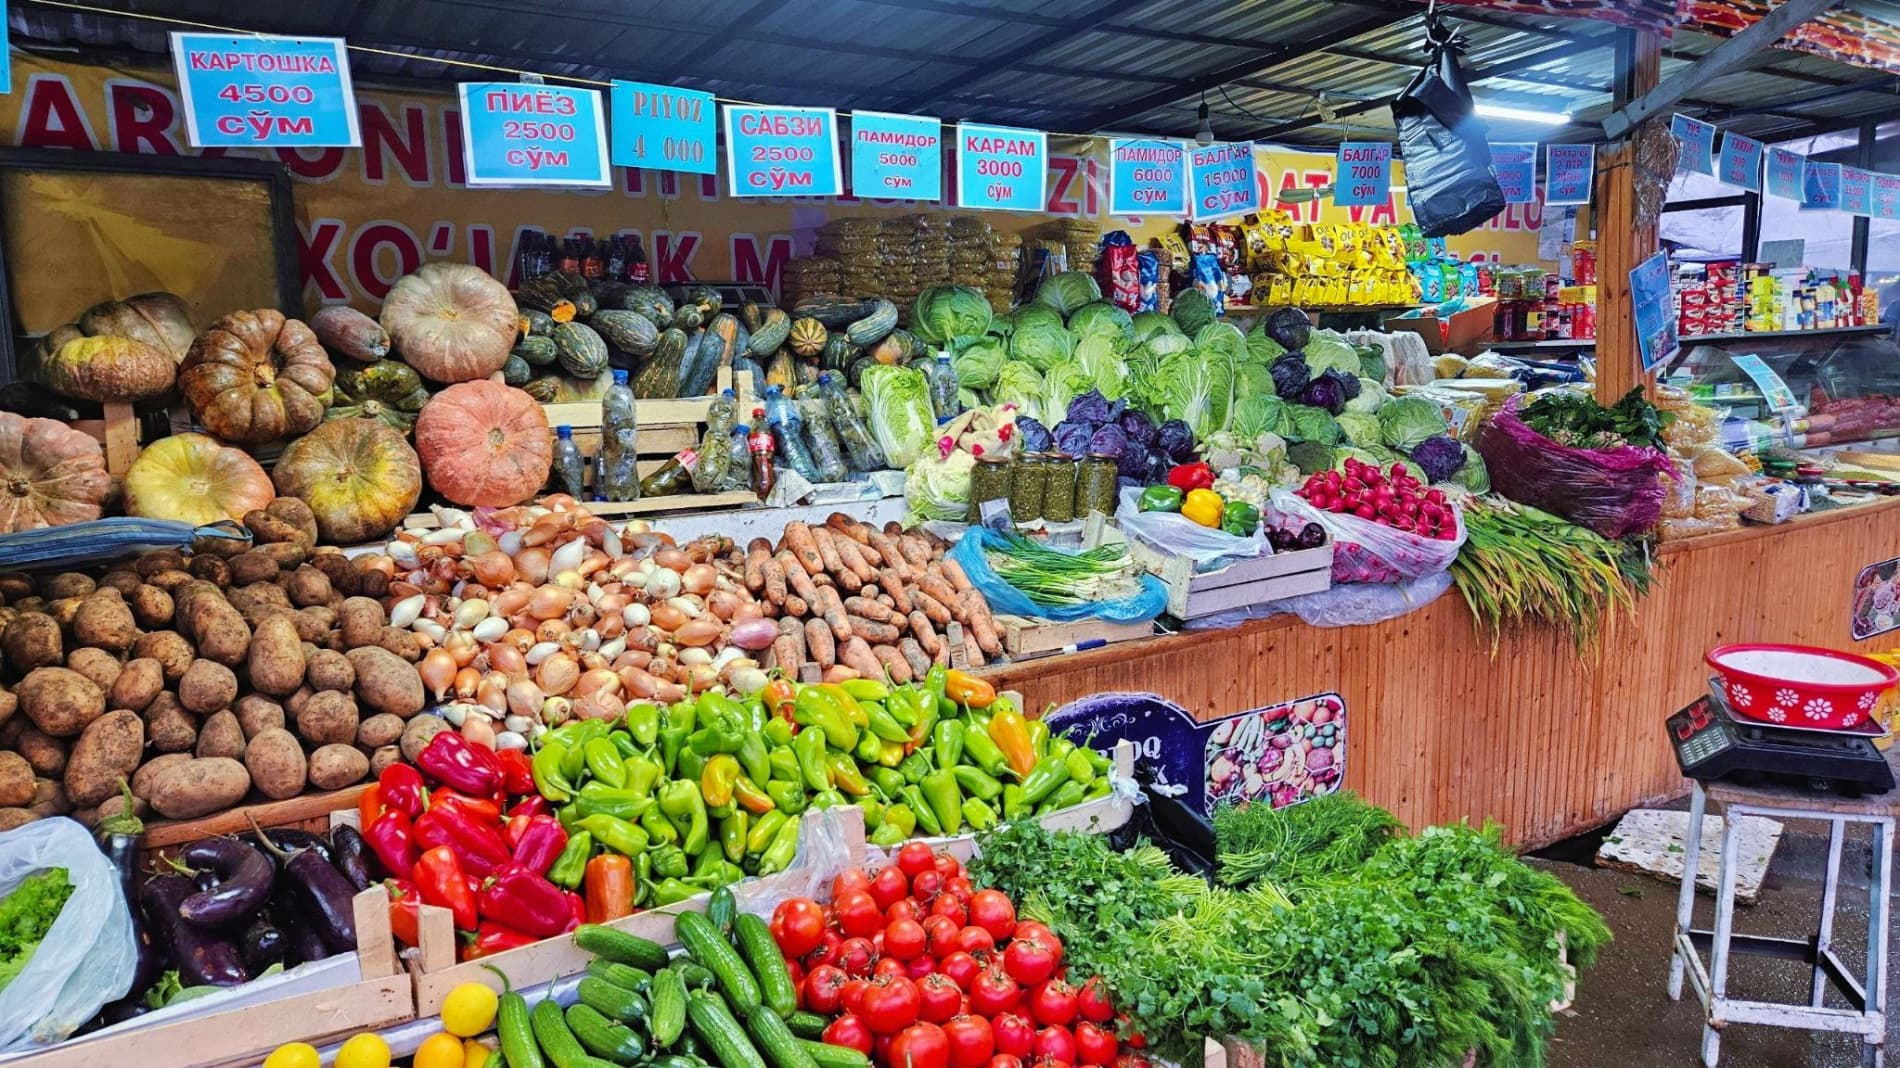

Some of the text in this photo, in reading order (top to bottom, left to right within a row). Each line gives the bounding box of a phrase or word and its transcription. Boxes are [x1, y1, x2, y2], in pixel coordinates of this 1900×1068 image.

[191, 52, 335, 73] КАРТОШКА
[219, 84, 314, 104] 4500
[486, 91, 577, 116] ПИЁЗ
[633, 91, 704, 123] PIYOZ
[217, 110, 313, 140] сўм
[503, 121, 576, 141] 2500
[740, 114, 823, 137] САБЗИ
[633, 134, 646, 160] 4
[857, 130, 937, 148] ПАМИДОР
[966, 136, 1036, 157] КАРАМ
[507, 146, 569, 170] сўм
[752, 146, 814, 162] 2500
[879, 153, 917, 167] 5000
[1116, 147, 1183, 165] ПАМИДОР
[1194, 145, 1249, 167] БАЛГАР
[1342, 148, 1389, 162] БАЛГАР
[977, 159, 1023, 177] 3000
[1133, 168, 1173, 182] 6000
[1204, 168, 1248, 188] 15000
[1351, 165, 1381, 179] 7000
[749, 167, 812, 190] сўм
[987, 183, 1013, 201] сўм
[1133, 186, 1168, 204] сўм
[1203, 190, 1250, 211] сўм
[1352, 184, 1377, 198] сўм
